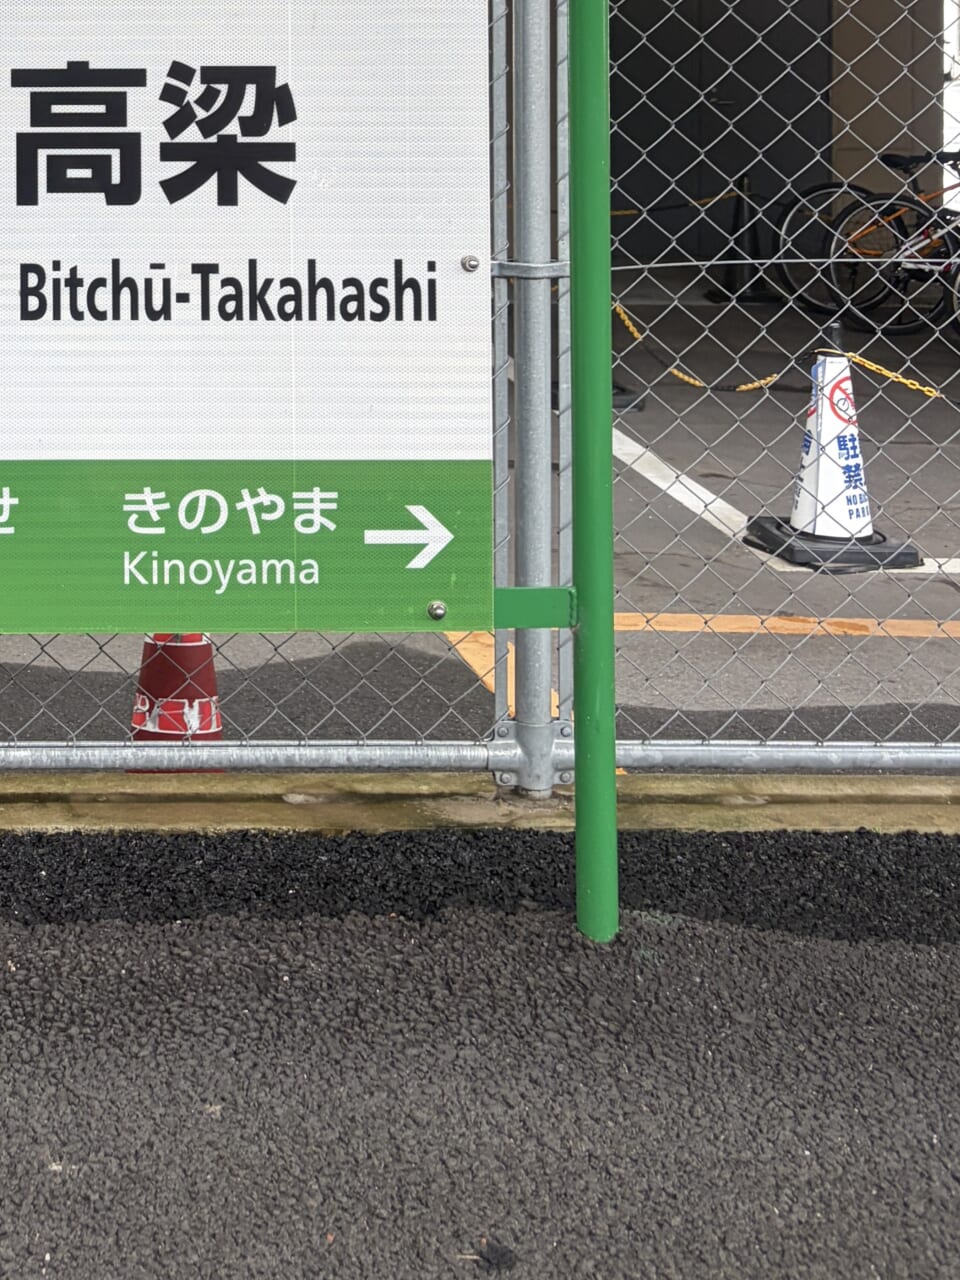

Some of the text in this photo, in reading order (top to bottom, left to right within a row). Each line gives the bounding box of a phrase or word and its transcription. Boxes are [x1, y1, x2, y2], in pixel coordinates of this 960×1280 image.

[19, 258, 438, 322] Bitchū-Takahashi
[122, 486, 339, 536] きのやま
[122, 551, 320, 596] Kinoyama
